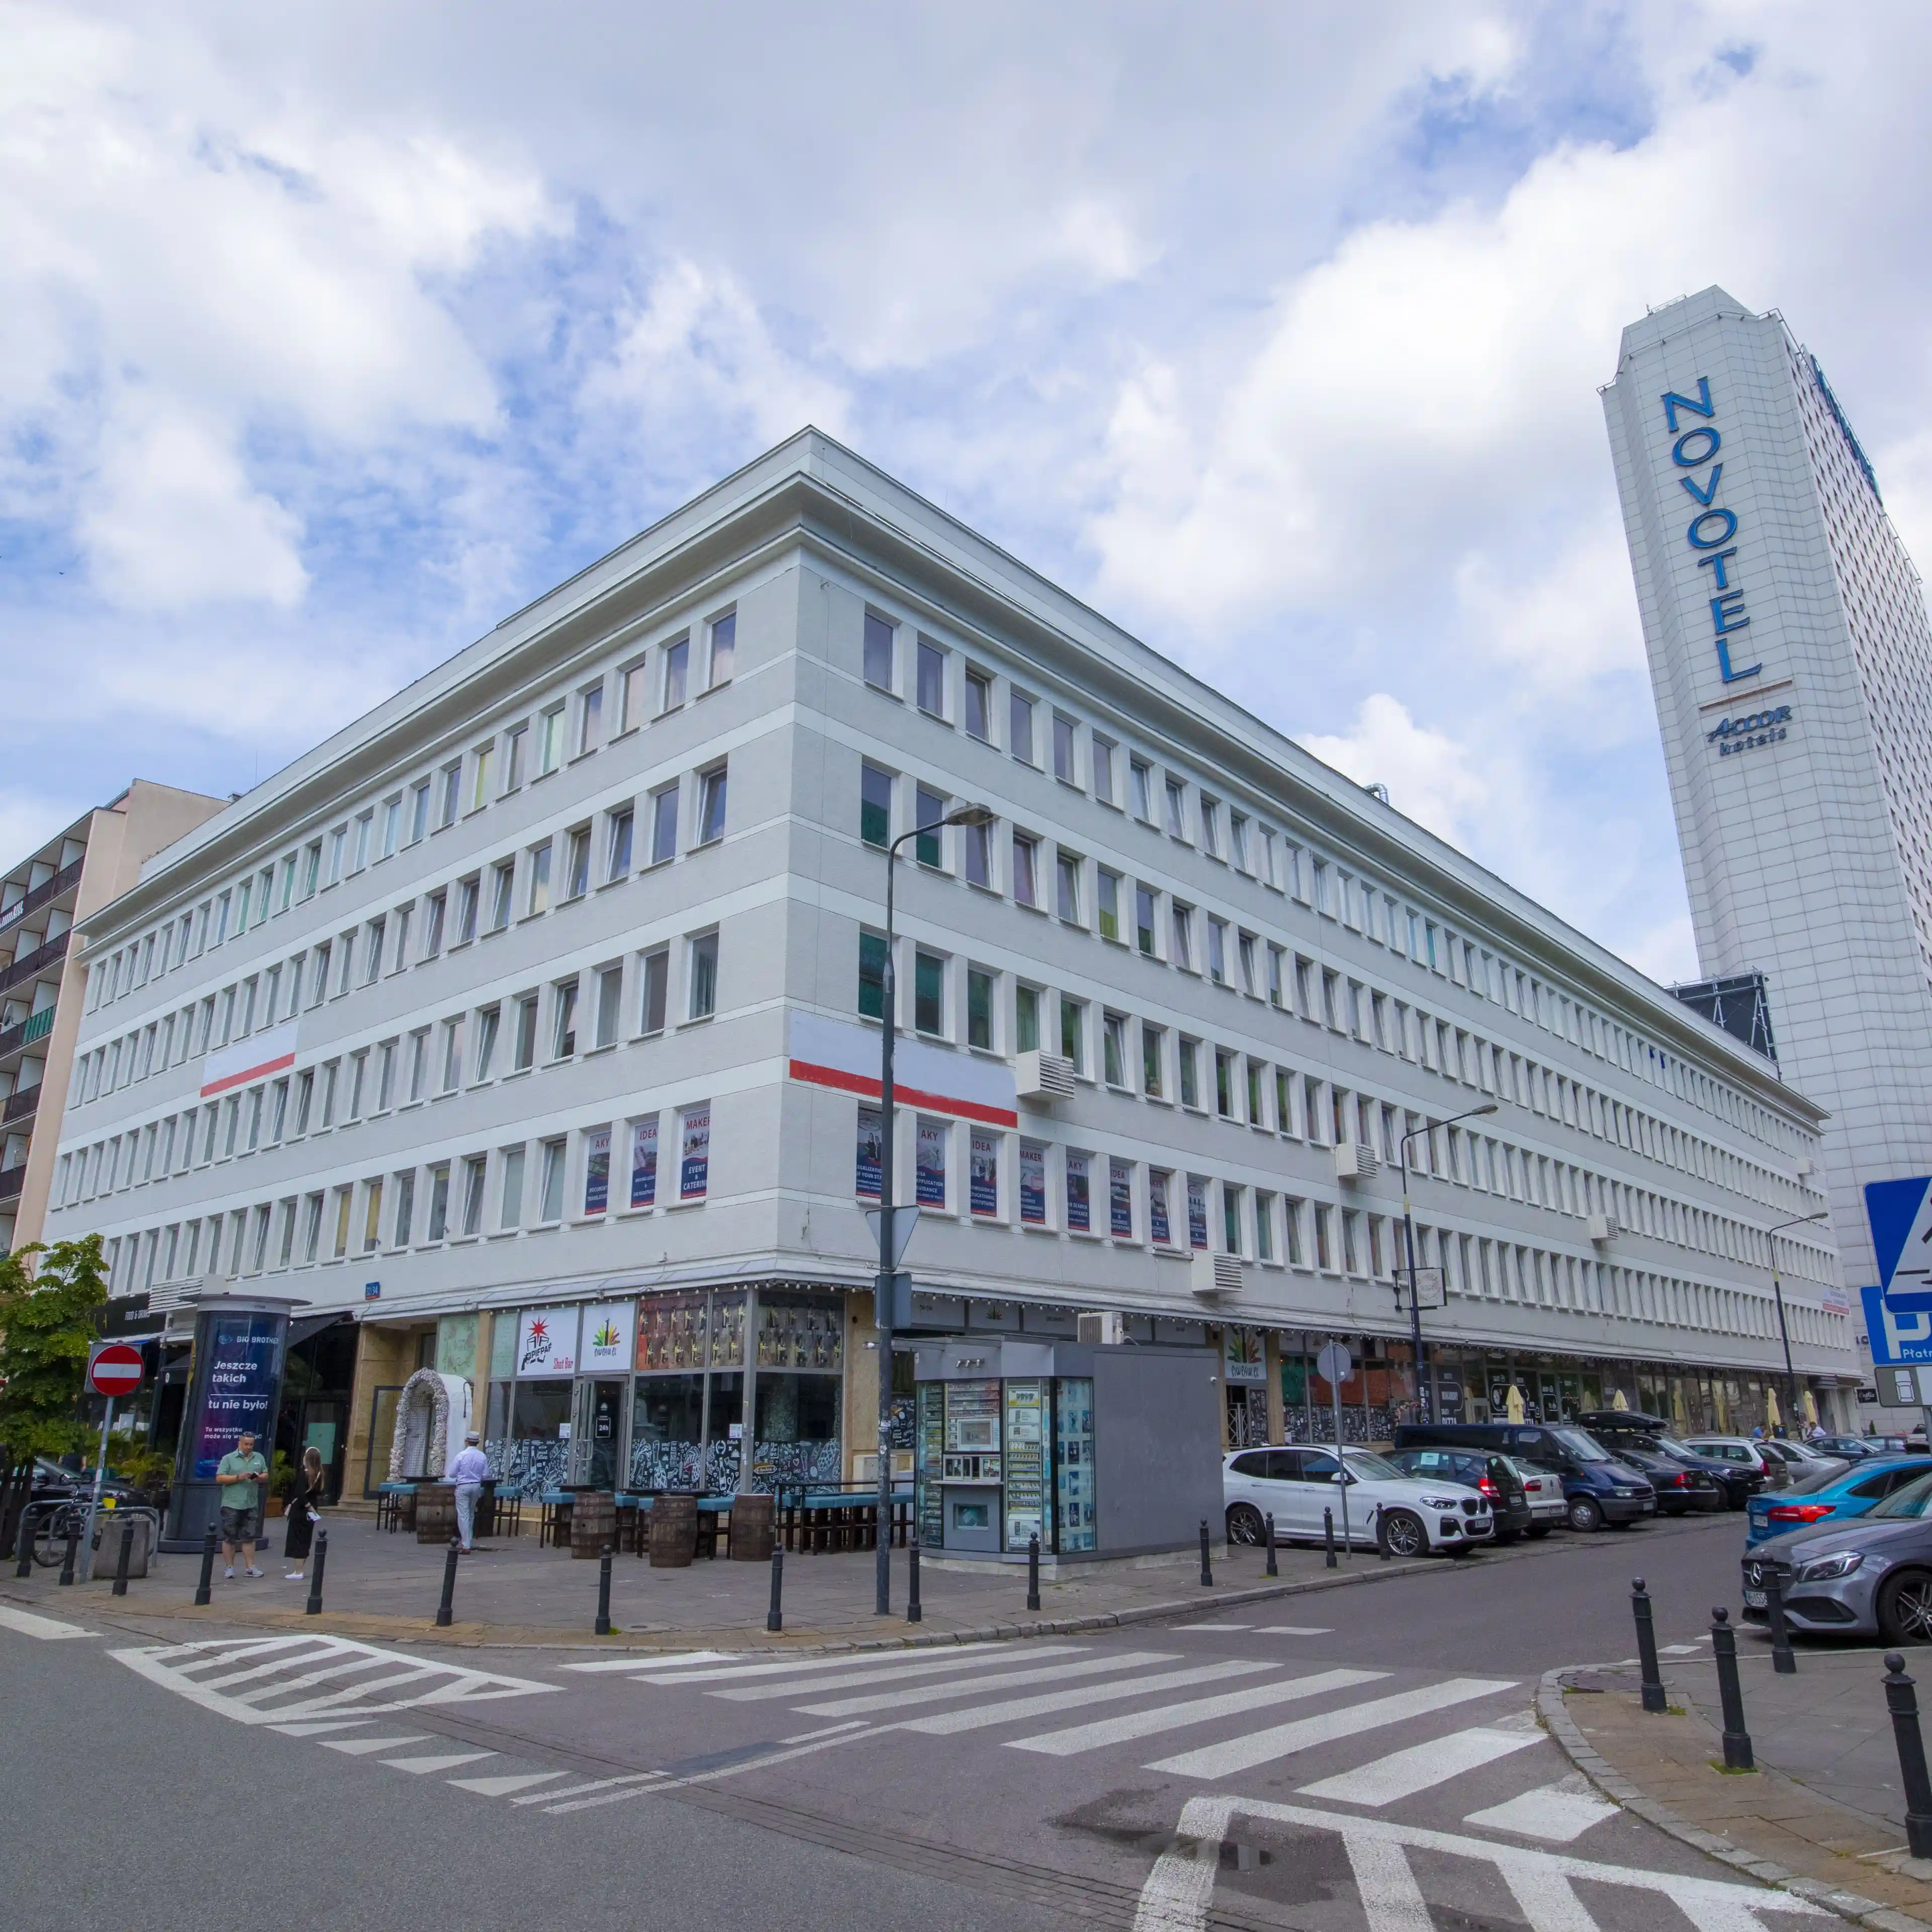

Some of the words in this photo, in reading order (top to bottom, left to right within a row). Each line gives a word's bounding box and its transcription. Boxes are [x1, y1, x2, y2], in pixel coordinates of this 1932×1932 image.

[1660, 375, 1762, 684] NOVOTEL
[1706, 705, 1793, 742] ACCOR
[1720, 728, 1787, 756] hotels
[640, 1129, 657, 1141] IDEA
[921, 1130, 938, 1141] AKY
[595, 1138, 609, 1149] AKY
[972, 1140, 991, 1153] IDEA
[1020, 1150, 1042, 1163] MAKER
[688, 1164, 705, 1174] EVENT
[1069, 1160, 1082, 1171] AKY
[214, 1360, 258, 1371] Jeszcze
[553, 1358, 564, 1370] Shot
[565, 1357, 574, 1369] Bar
[212, 1374, 247, 1383] takich
[208, 1401, 219, 1409] tu
[222, 1400, 240, 1409] nie
[243, 1400, 268, 1411] było!
